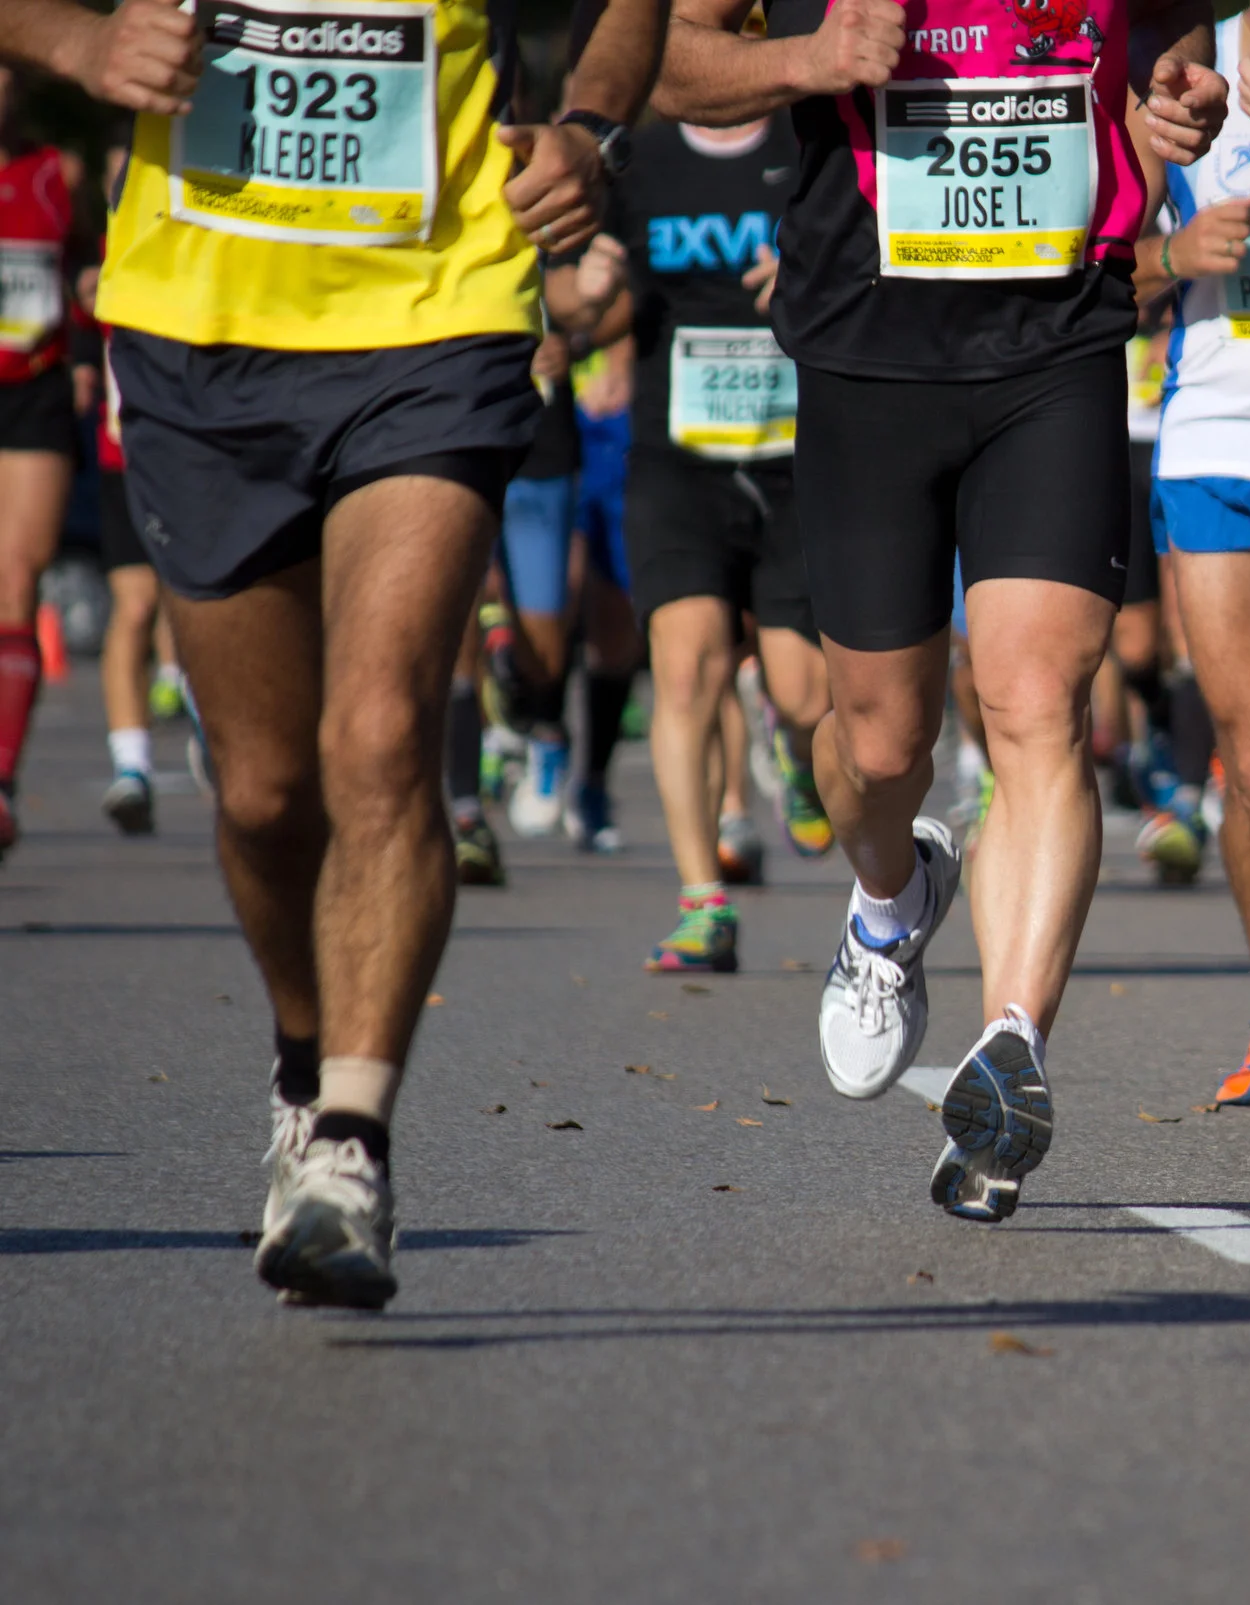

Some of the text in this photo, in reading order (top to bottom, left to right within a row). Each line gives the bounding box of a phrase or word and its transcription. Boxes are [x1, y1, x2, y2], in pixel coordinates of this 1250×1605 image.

[281, 20, 404, 55] adidas
[908, 24, 989, 54] TROT
[235, 64, 380, 122] 1923
[970, 95, 1069, 122] adidas
[238, 121, 363, 184] KLEBER
[926, 134, 1052, 177] 2655
[941, 185, 1038, 228] JOSE L.
[935, 253, 974, 263] ALFONSO
[975, 254, 993, 263] 2012
[966, 246, 1005, 255] VALENCIA
